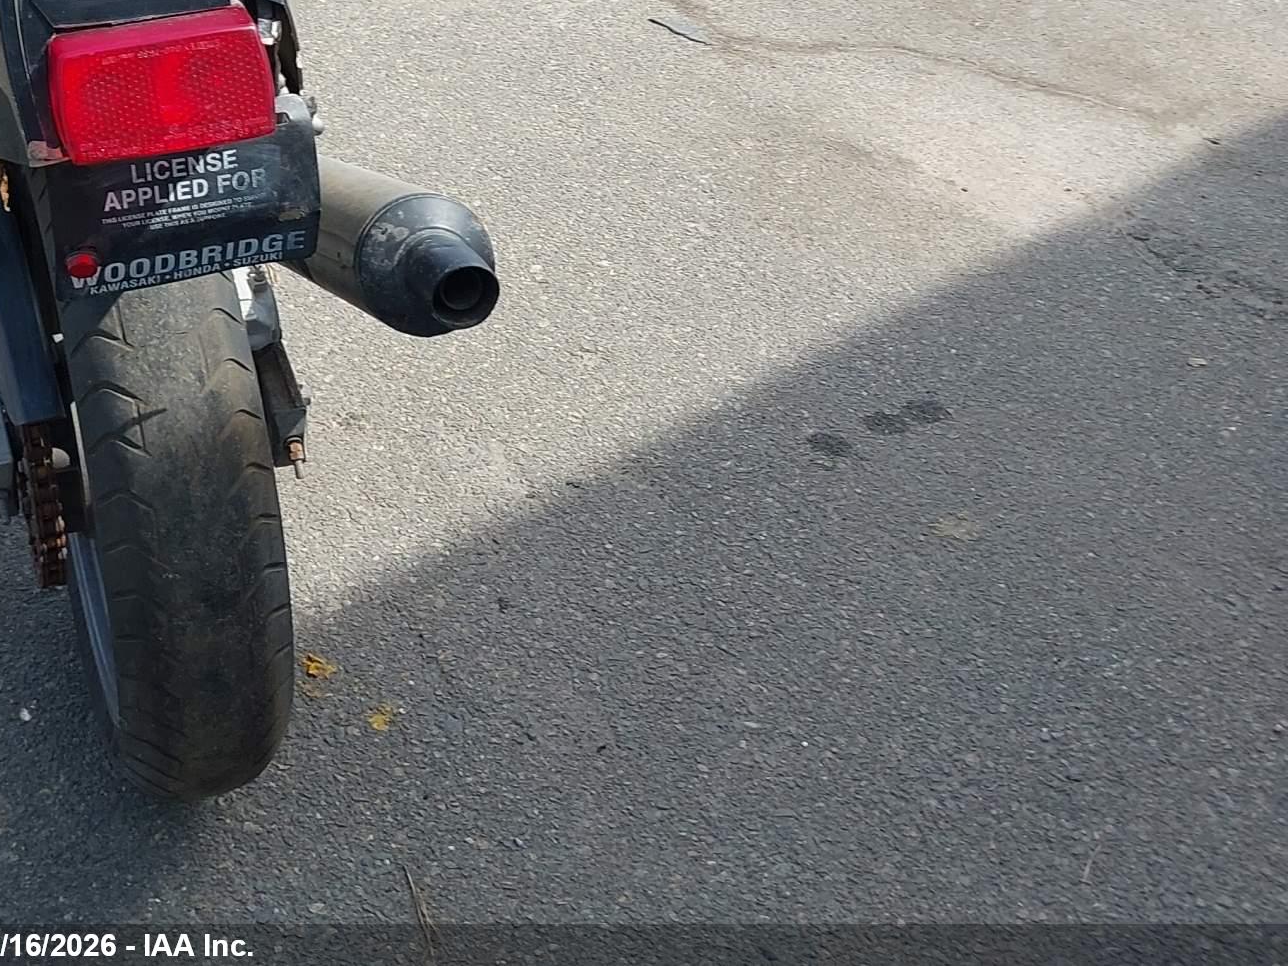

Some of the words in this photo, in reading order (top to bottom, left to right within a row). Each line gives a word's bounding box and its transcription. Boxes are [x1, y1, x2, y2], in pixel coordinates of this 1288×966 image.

[131, 149, 238, 184] LICENSE
[103, 178, 208, 212] APPLIED
[217, 168, 266, 194] FOR
[118, 213, 146, 222] LICENSE
[147, 209, 167, 217] PLATE
[89, 274, 161, 295] KAWASAKI
[173, 262, 222, 279] HONDA
[233, 251, 283, 266] SUZUKI
